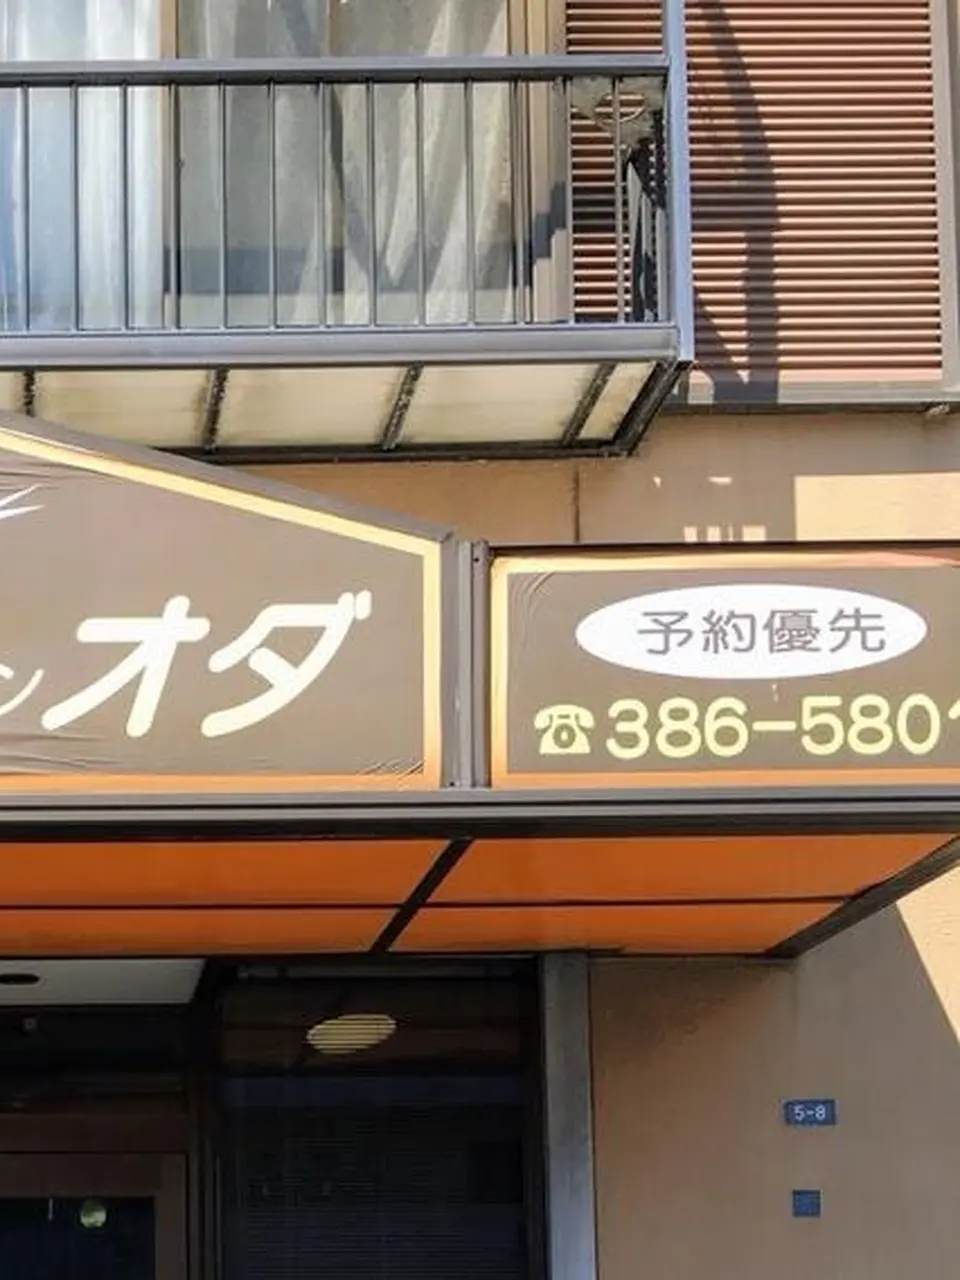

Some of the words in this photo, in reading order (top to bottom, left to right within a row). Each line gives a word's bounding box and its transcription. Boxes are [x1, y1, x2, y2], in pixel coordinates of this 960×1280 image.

[638, 608, 886, 655] 予約優先
[40, 590, 372, 738] オダ
[606, 694, 960, 759] 386-580
[794, 1105, 826, 1121] 5-8
